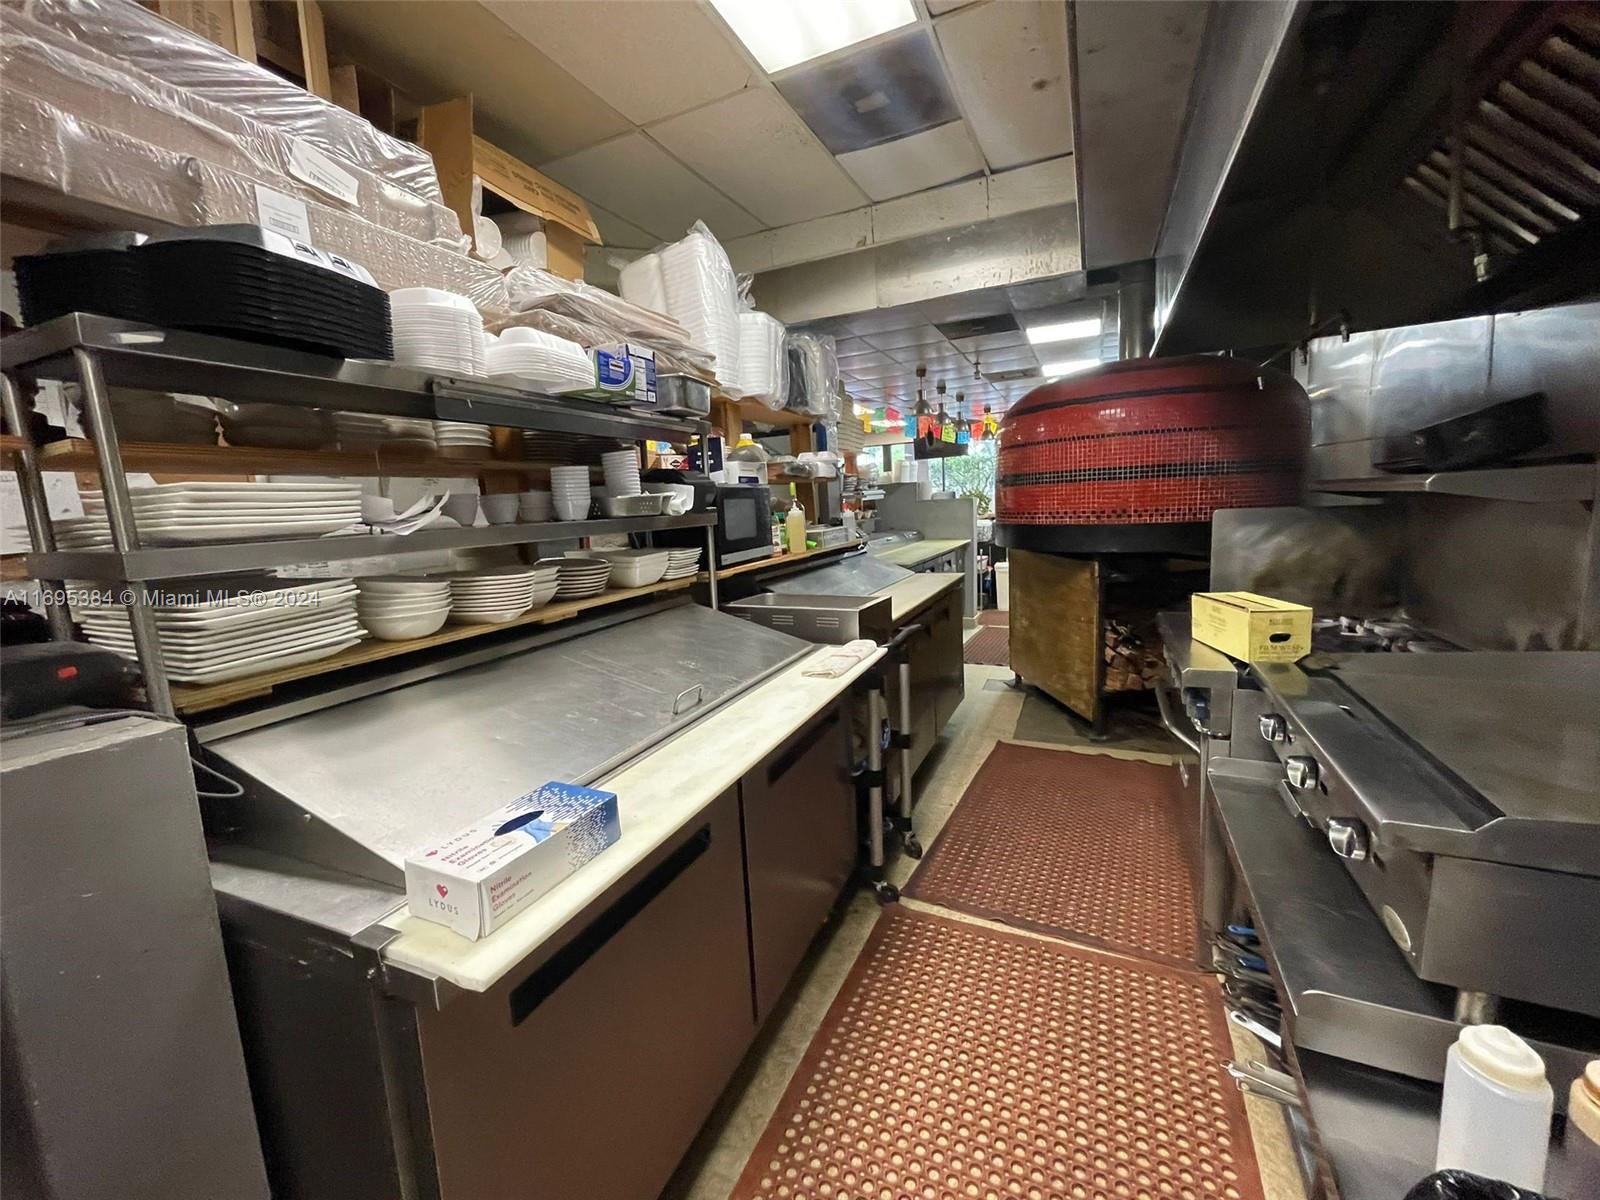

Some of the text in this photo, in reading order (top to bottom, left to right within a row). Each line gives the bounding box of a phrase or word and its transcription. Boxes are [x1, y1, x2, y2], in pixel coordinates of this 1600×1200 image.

[490, 875, 512, 894] Nitrile
[491, 871, 532, 903] Examination
[428, 897, 459, 916] LYDUS
